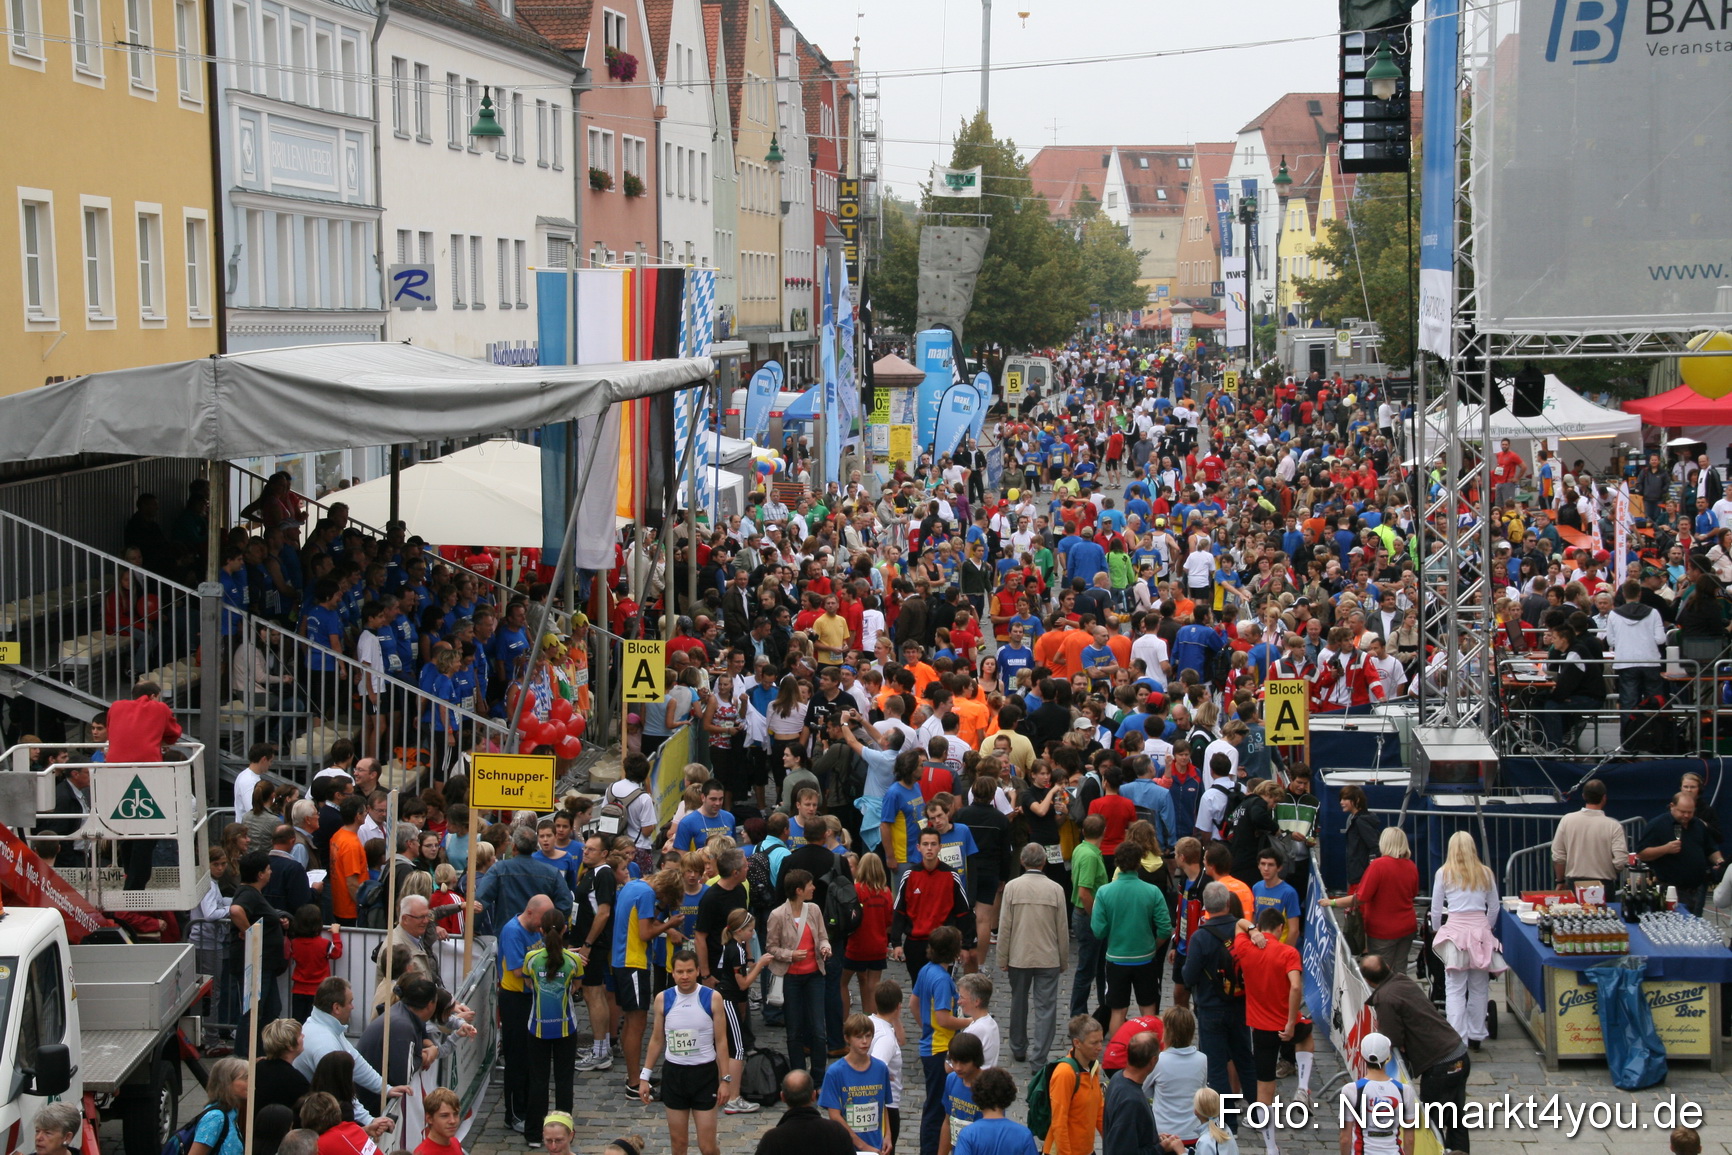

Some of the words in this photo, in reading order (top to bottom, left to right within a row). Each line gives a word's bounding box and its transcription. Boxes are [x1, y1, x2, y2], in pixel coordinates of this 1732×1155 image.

[271, 141, 301, 170] BRILLEN
[302, 148, 333, 177] WEBER
[1648, 264, 1729, 280] www.
[1010, 378, 1018, 388] B
[1227, 378, 1234, 388] B
[628, 642, 660, 654] Block
[631, 658, 656, 689] A
[1269, 683, 1304, 695] Block
[1274, 699, 1300, 731] A
[477, 769, 549, 784] Schnupper-
[501, 785, 525, 796] lauf
[1674, 1004, 1707, 1018] Bier
[676, 1039, 698, 1049] 5147
[856, 1113, 876, 1124] 5137
